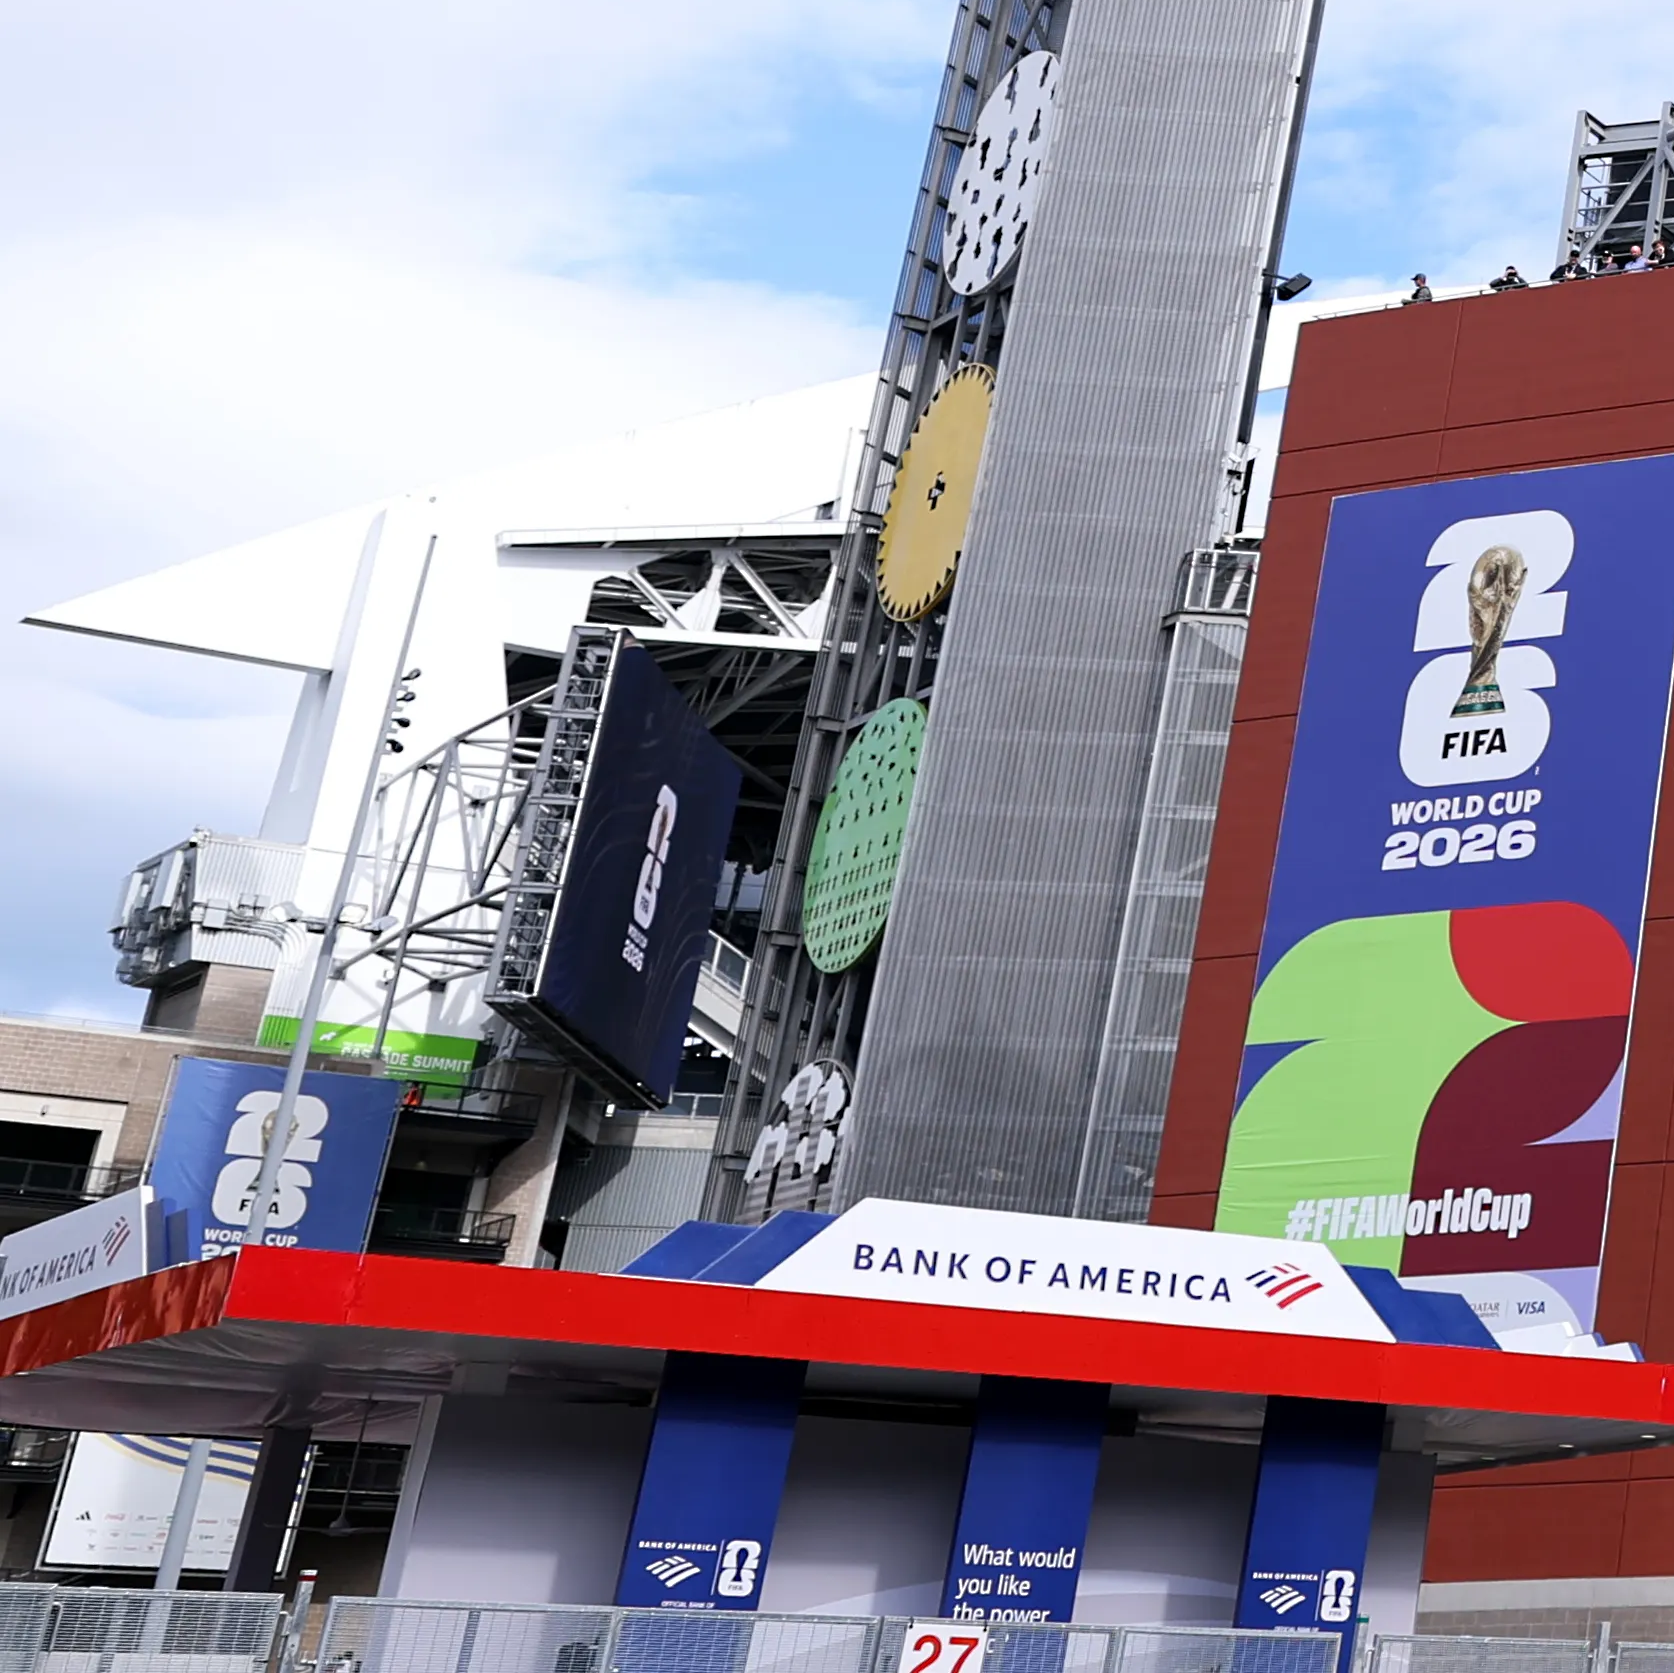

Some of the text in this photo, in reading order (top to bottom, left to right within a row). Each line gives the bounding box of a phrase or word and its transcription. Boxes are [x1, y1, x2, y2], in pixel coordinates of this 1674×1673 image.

[1442, 728, 1507, 759] FIFA
[1391, 789, 1542, 826] WORLD CUP
[1381, 820, 1537, 871] 2026
[412, 1055, 472, 1073] SUMMIT
[239, 1198, 280, 1215] FA
[1285, 1188, 1532, 1241] #FIFAWorldCup
[204, 1228, 298, 1247] WOR CUP
[19, 1265, 39, 1294] OF
[35, 1244, 97, 1290] AMERICA
[853, 1244, 1232, 1303] BANK OF AMERICA
[1517, 1301, 1546, 1315] VISA
[638, 1541, 717, 1552] BANK OF AMERICA
[964, 1543, 1076, 1569] What would
[955, 1574, 1031, 1600] you like
[1252, 1572, 1273, 1580] BANK
[1285, 1573, 1319, 1581] AMERICA
[952, 1602, 984, 1622] the
[908, 1634, 980, 1673] 27
